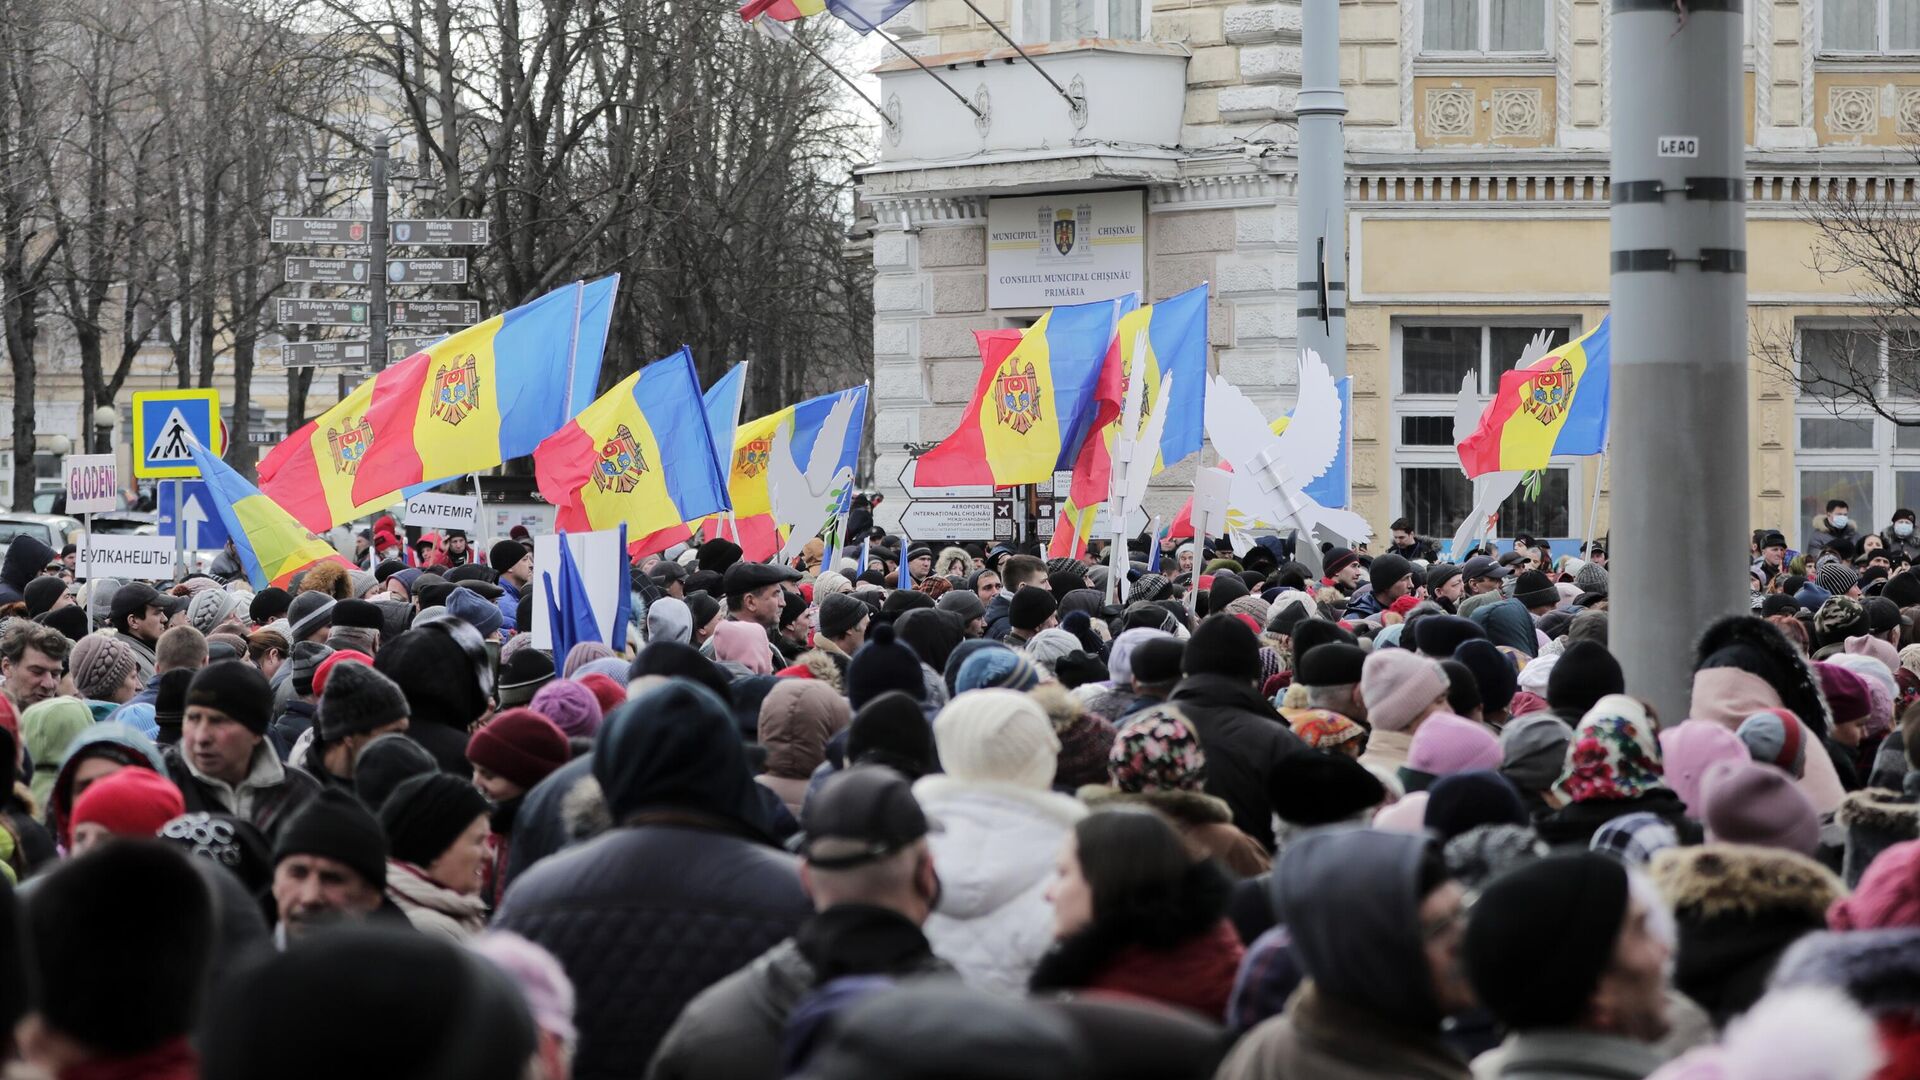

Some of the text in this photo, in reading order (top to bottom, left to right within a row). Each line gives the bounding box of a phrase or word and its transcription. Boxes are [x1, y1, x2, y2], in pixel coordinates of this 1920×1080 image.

[303, 221, 338, 230] Odessa
[426, 222, 453, 231] Minsk
[479, 226, 485, 238] km
[992, 231, 1038, 241] MUNICIPIUL
[409, 261, 444, 270] Grenoble
[999, 274, 1043, 285] CONSILIUL
[1044, 272, 1089, 283] MUNICIPAL
[1044, 287, 1085, 297] PRIMĂRIA
[298, 302, 309, 310] Tel
[310, 302, 327, 310] Aviv
[332, 302, 350, 311] Yafo
[408, 303, 459, 313] Reggio Emilia
[470, 308, 477, 319] km
[312, 343, 337, 353] Tbilisi
[70, 465, 115, 501] GLODENI
[410, 502, 473, 518] CANTEMIR
